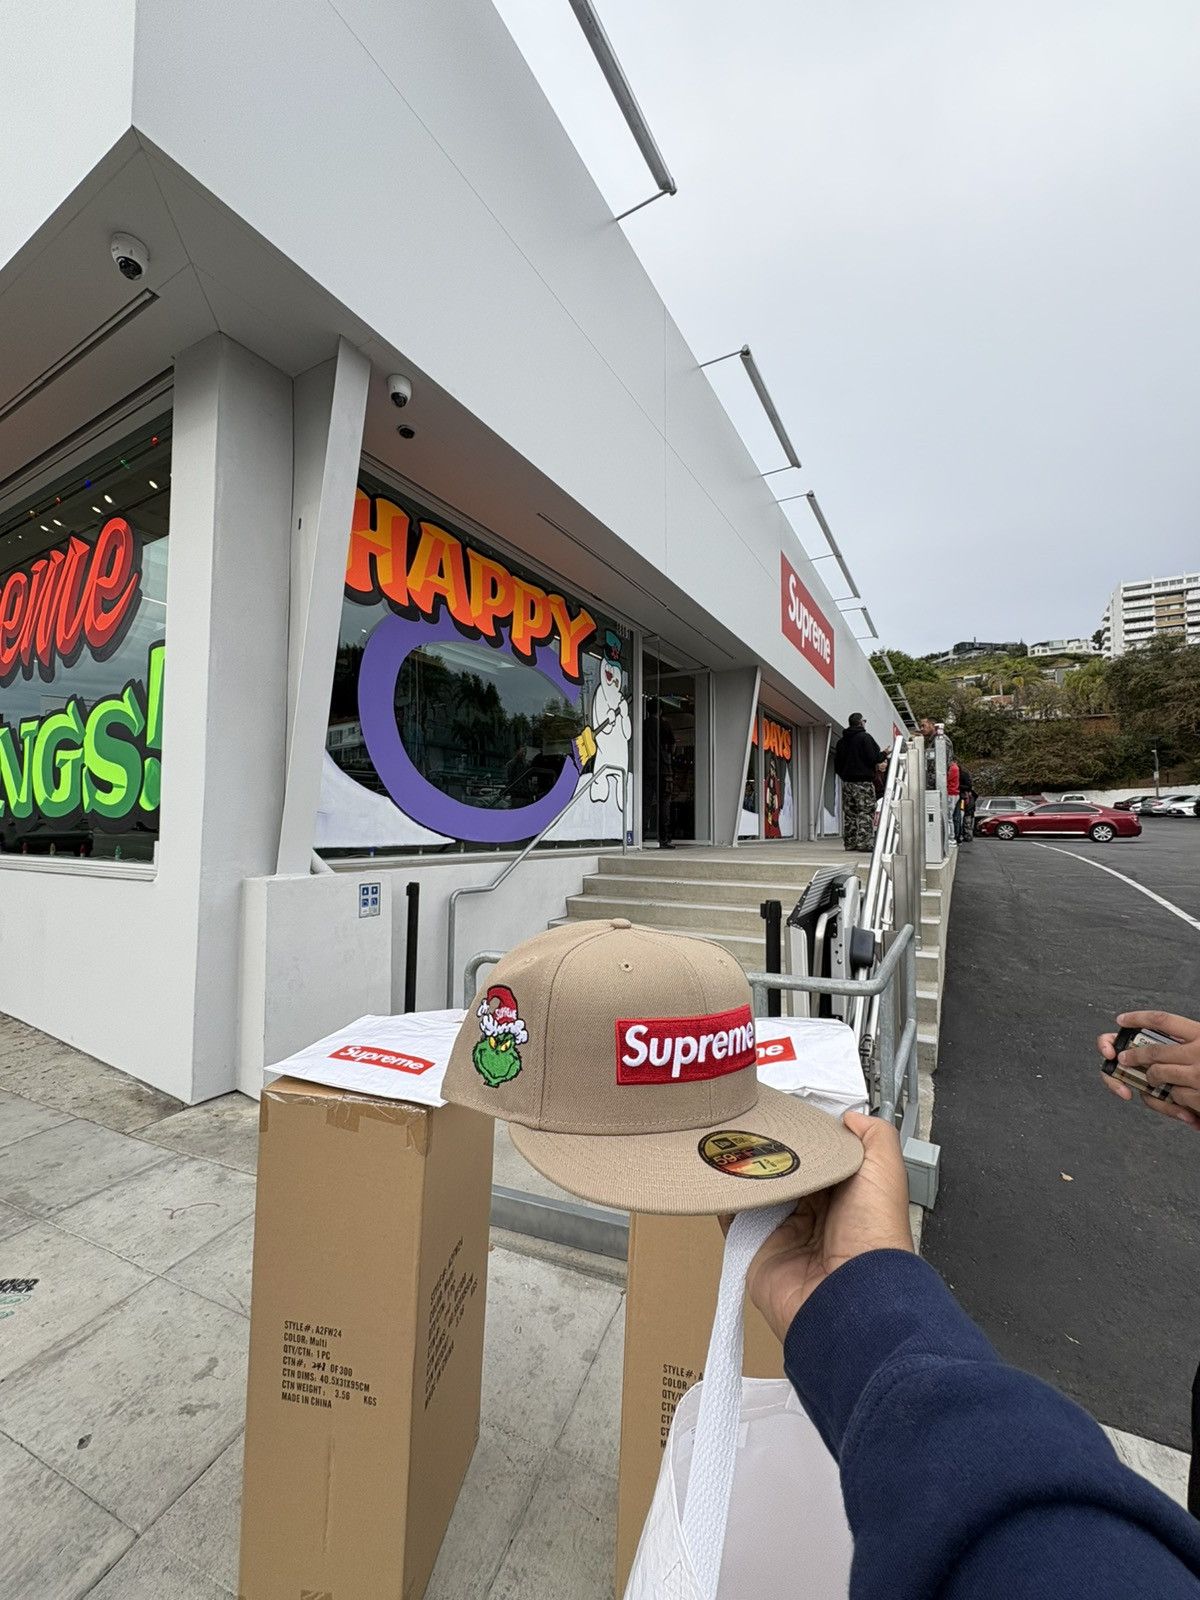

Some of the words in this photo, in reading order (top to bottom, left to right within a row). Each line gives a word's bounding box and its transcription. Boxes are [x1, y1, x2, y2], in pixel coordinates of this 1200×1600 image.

[345, 487, 597, 679] HAPPY
[788, 573, 832, 665] Supreme
[339, 1045, 425, 1071] Supreme
[622, 1021, 754, 1078] Supreme
[310, 1336, 328, 1347] Multi
[315, 1325, 342, 1338] A2FW24
[282, 1368, 296, 1378] CTN
[281, 1379, 295, 1390] CTN
[363, 1395, 377, 1407] KGS
[281, 1391, 300, 1403] MADE
[301, 1394, 309, 1404] IN
[310, 1396, 332, 1409] CHINA
